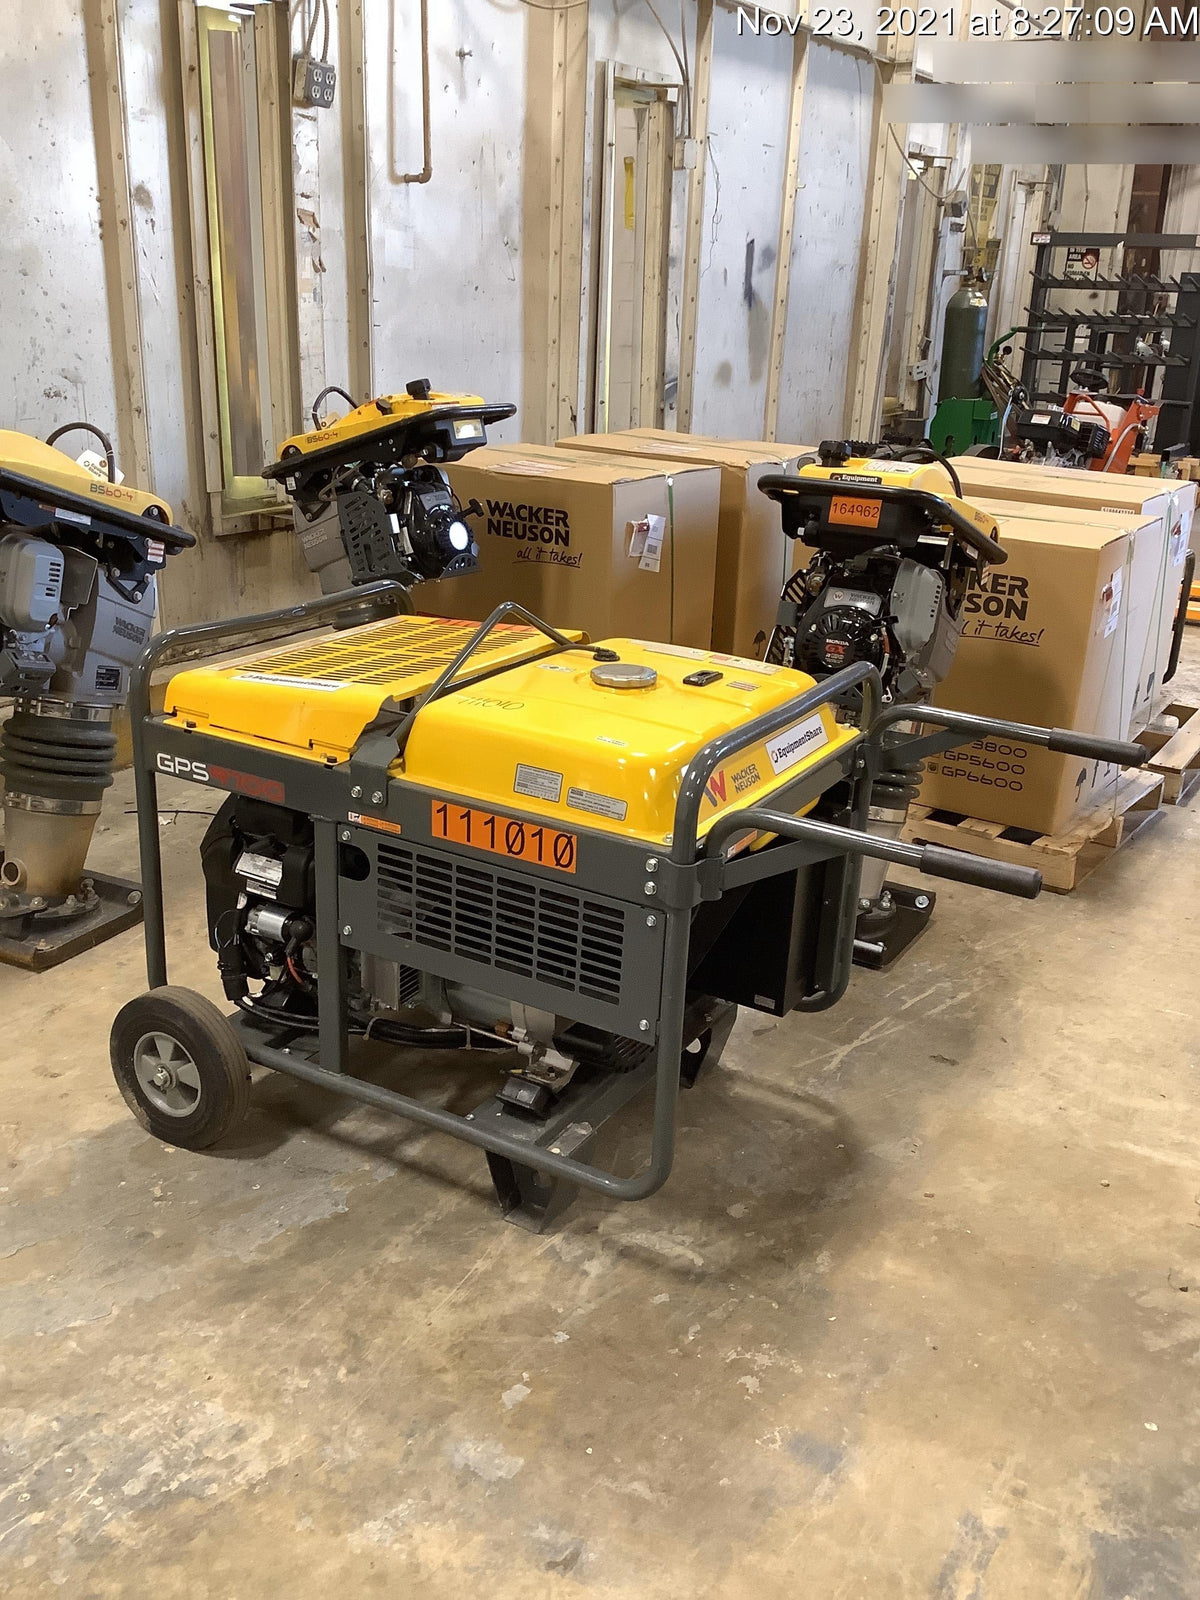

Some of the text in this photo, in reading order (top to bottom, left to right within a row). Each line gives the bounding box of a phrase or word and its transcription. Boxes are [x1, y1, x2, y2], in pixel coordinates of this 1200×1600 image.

[842, 474, 878, 483] Equipment
[90, 483, 134, 501] BS60-4
[486, 499, 570, 528] WACKER
[832, 502, 880, 518] 164962
[487, 518, 570, 547] NEUSON
[516, 546, 583, 567] all it takes!
[964, 593, 1029, 621] SON
[826, 638, 850, 647] HONDA
[974, 620, 993, 636] it
[994, 621, 1045, 643] takes!
[825, 644, 847, 655] GX
[776, 725, 823, 759] EquipmentShare
[731, 763, 759, 784] WACKER
[943, 750, 1026, 775] GP5600
[734, 772, 761, 794] NEUSON
[941, 765, 1023, 791] GP6600
[436, 802, 574, 869] 111010
